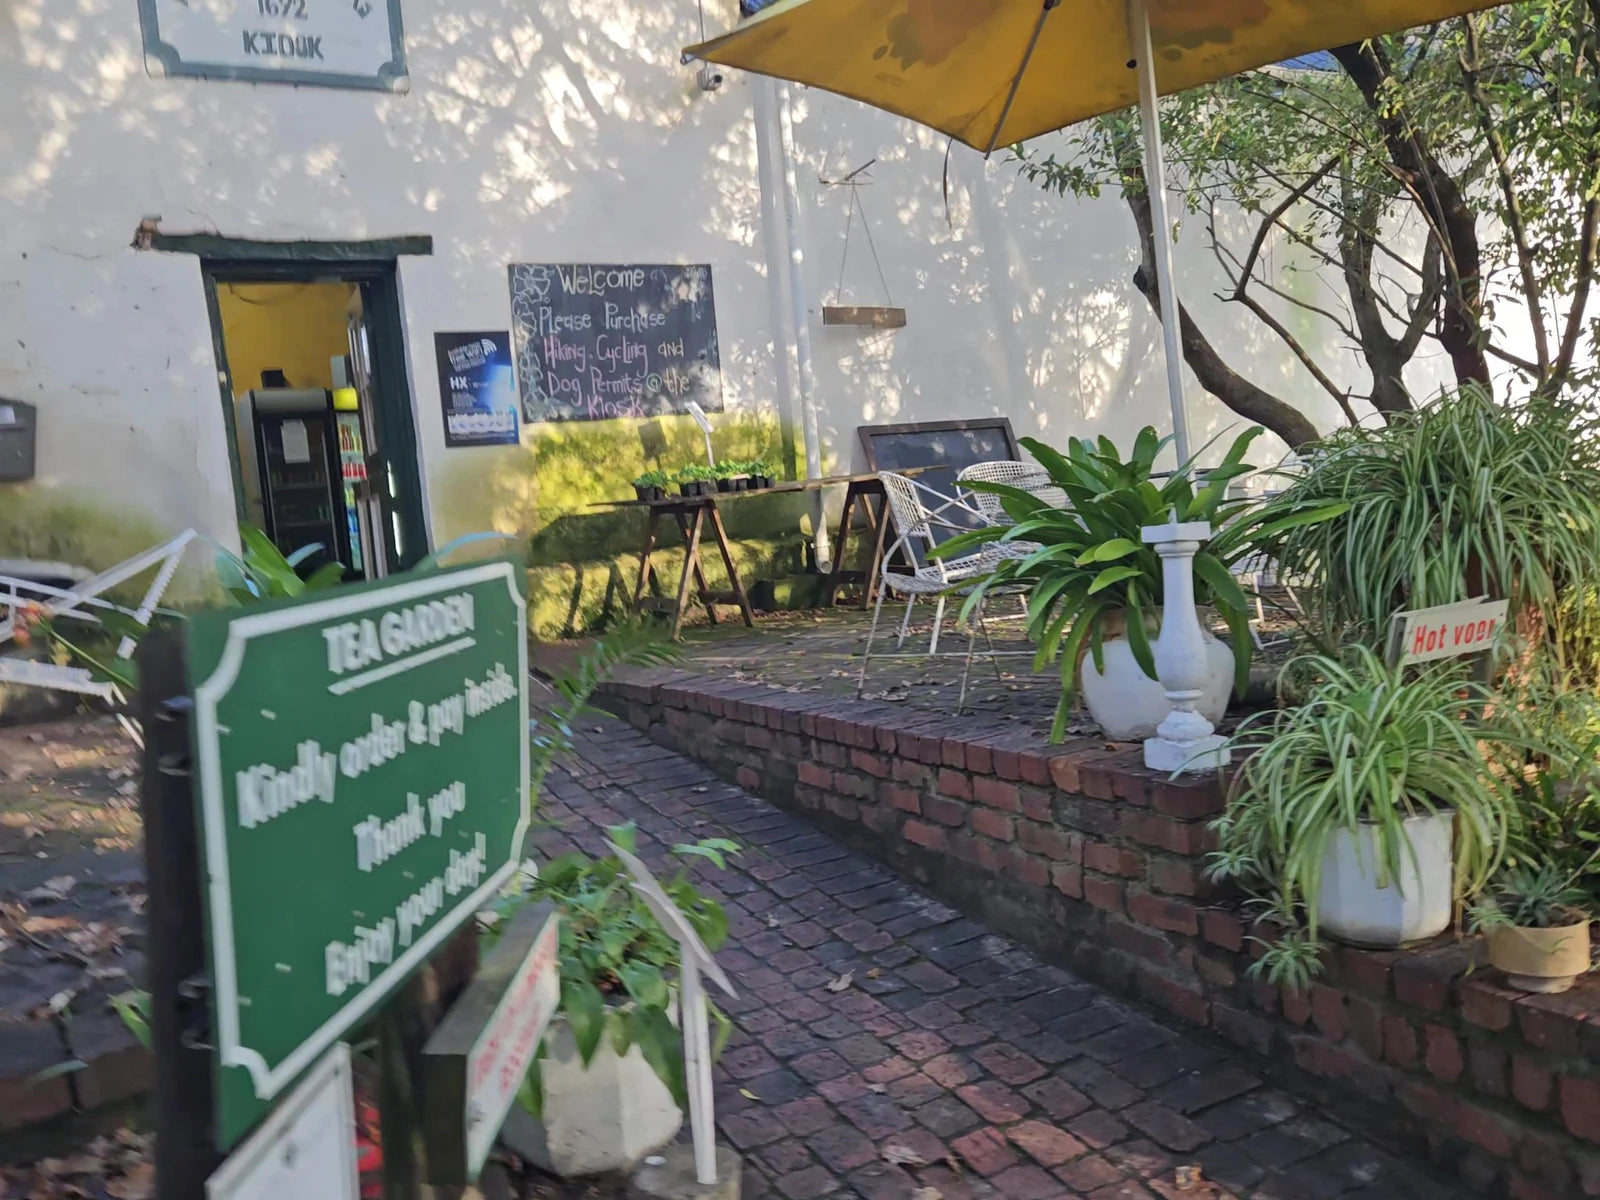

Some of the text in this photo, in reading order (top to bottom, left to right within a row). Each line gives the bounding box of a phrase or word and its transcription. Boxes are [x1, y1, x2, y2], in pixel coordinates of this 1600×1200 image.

[605, 301, 666, 333] Purchase
[547, 370, 583, 407] Dog
[590, 364, 643, 396] Permits
[662, 366, 690, 397] the
[321, 592, 475, 675] TEA GARDEN
[1412, 623, 1447, 655] Hot
[235, 738, 337, 830] Kindly
[339, 712, 408, 779] order
[408, 699, 429, 745] &
[352, 780, 467, 874] Thank you
